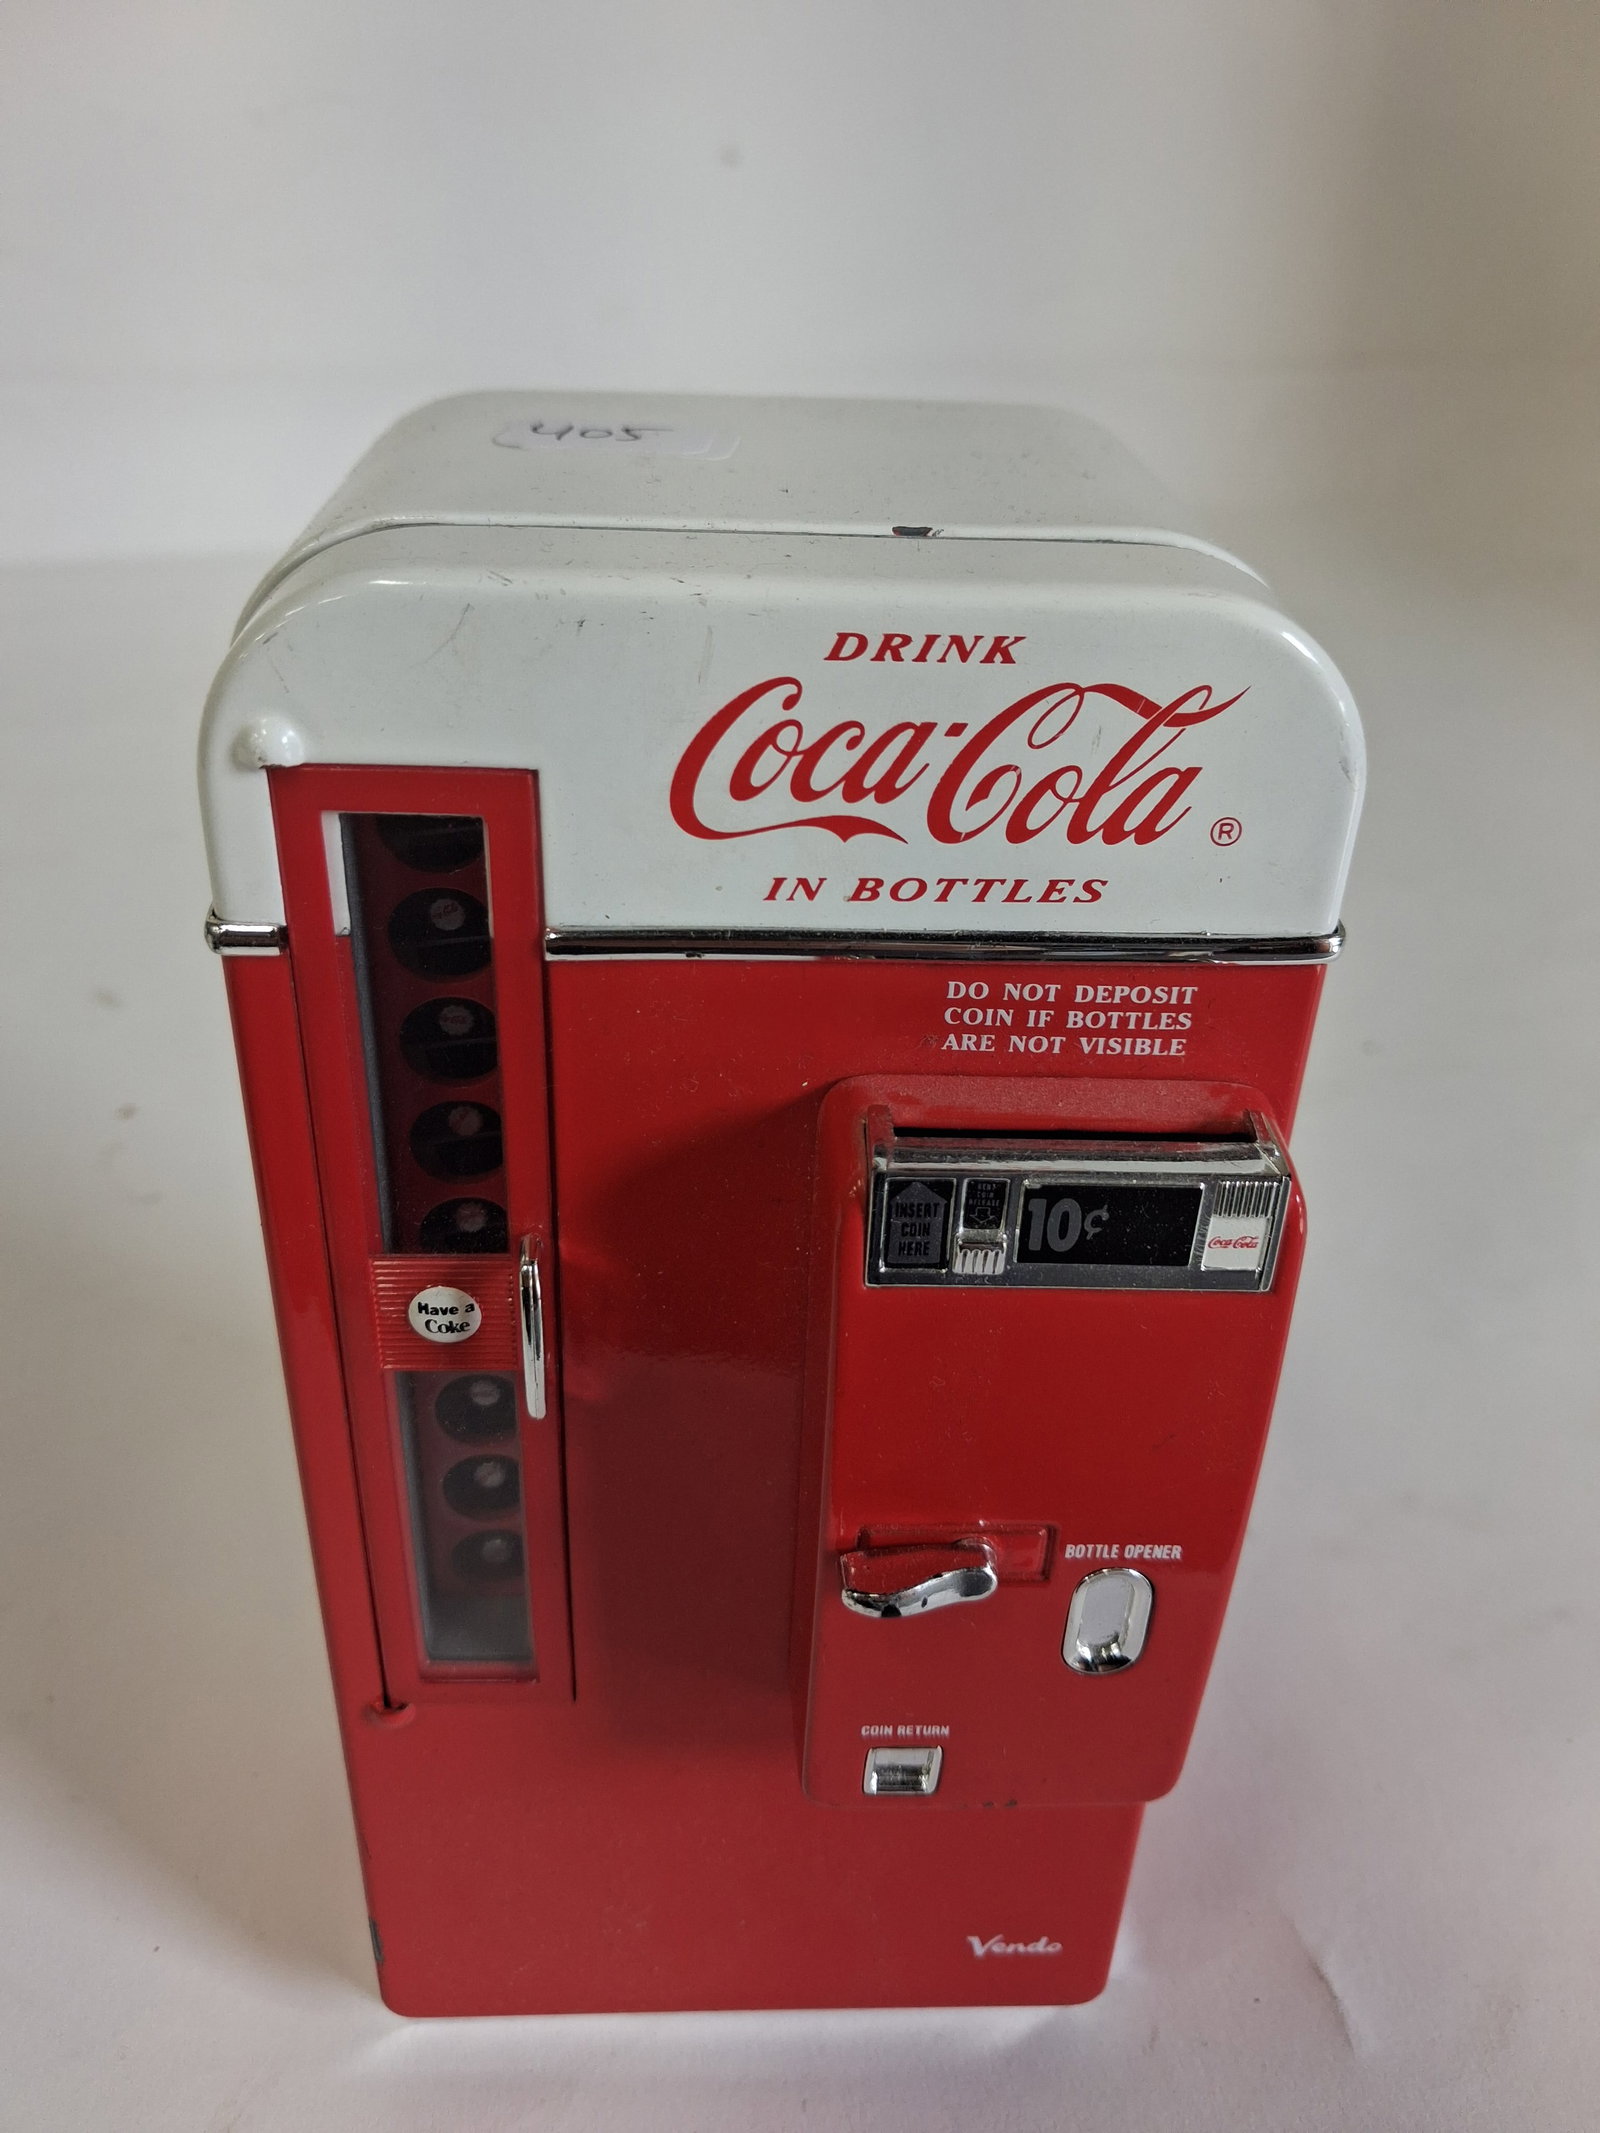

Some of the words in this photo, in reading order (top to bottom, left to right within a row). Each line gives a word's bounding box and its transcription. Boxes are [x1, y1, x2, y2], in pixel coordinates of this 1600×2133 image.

[824, 632, 1027, 664] DRINK
[669, 676, 1251, 845] Coca-Cola
[763, 877, 827, 901] IN
[846, 878, 1109, 903] BOTTLES
[946, 981, 989, 1000] DO
[1003, 983, 1061, 1002] NOT
[1074, 985, 1198, 1005] DEPOSIT
[943, 1007, 1015, 1026] COIN
[1026, 1010, 1055, 1028] IF
[1065, 1011, 1192, 1031] BOTTLES
[941, 1034, 996, 1052] ARE
[1008, 1035, 1066, 1054] NOT
[1079, 1037, 1187, 1056] VISIBLE
[895, 1202, 940, 1218] INSERT
[901, 1222, 931, 1237] COIN
[1028, 1198, 1110, 1252] 10¢
[898, 1241, 931, 1256] HERE
[417, 1301, 459, 1316] Have
[465, 1303, 475, 1313] a
[425, 1318, 471, 1334] Coke
[1065, 1544, 1119, 1559] BOTTLE
[1124, 1544, 1182, 1560] OPENER
[861, 1725, 893, 1737] COIN
[897, 1725, 950, 1737] RETURN
[966, 1933, 1062, 1958] Vendo
